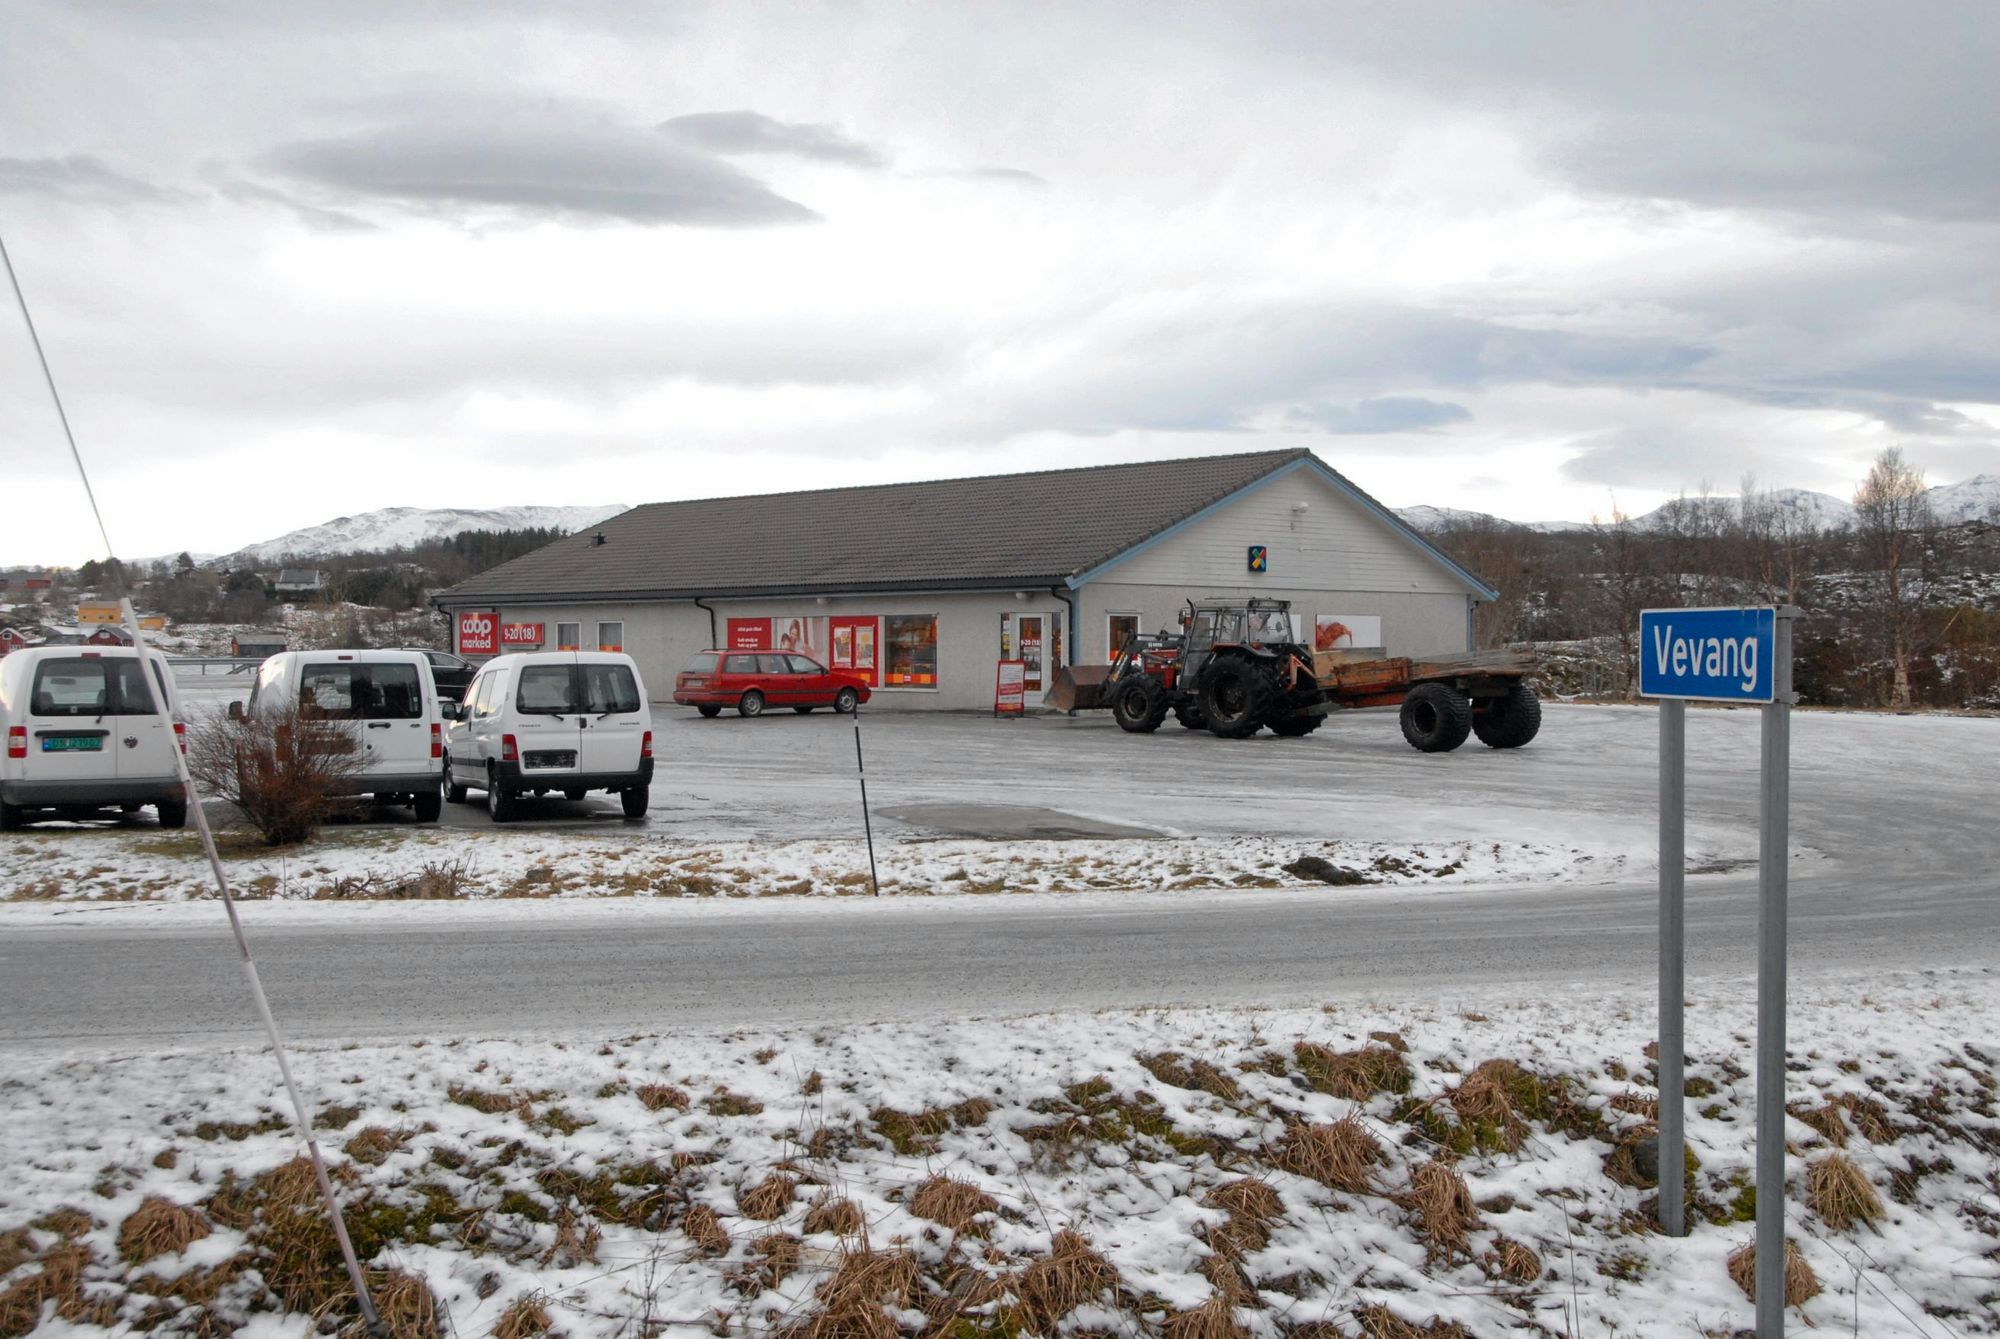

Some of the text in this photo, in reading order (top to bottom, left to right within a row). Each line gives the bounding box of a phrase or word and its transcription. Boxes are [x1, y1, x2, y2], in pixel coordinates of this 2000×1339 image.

[462, 619, 492, 637] coop
[504, 626, 536, 641] 9-20 (18)
[462, 635, 492, 649] marked
[1653, 624, 1758, 693] Vevang
